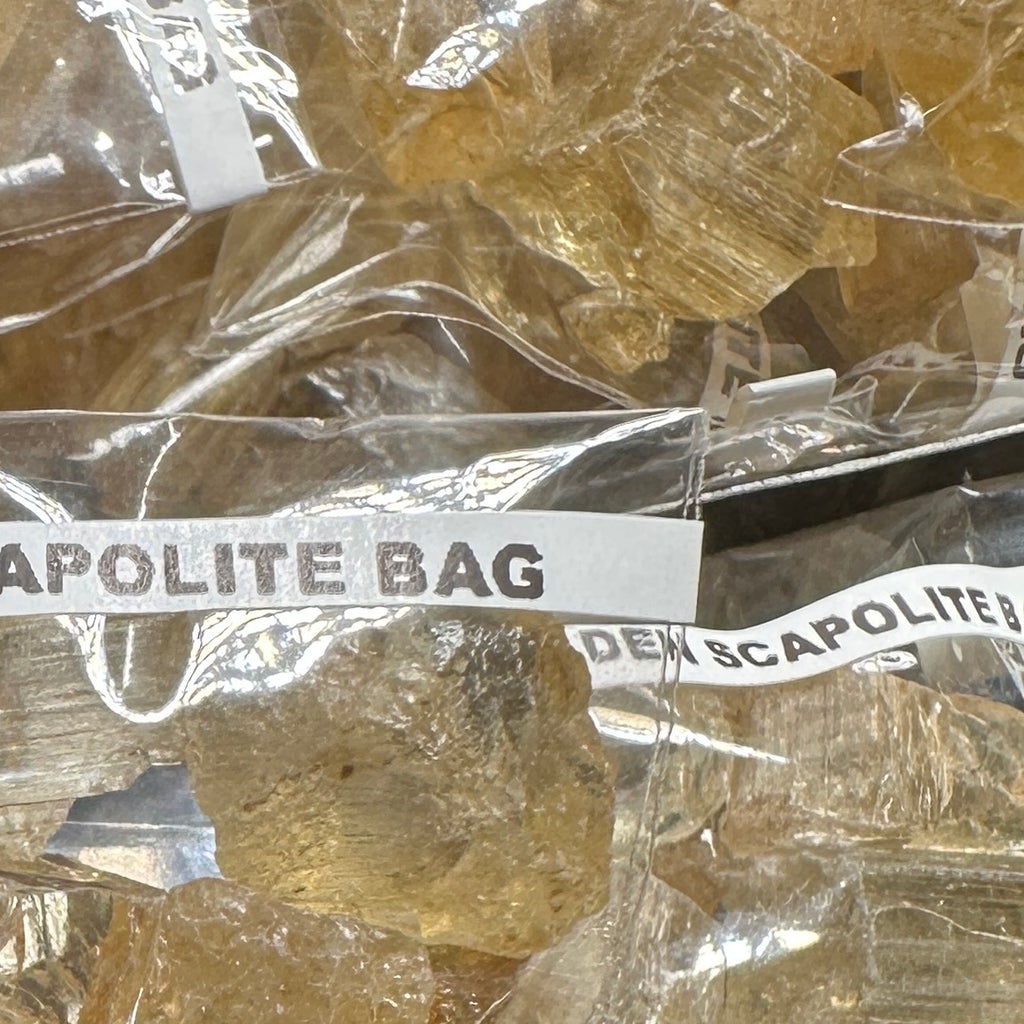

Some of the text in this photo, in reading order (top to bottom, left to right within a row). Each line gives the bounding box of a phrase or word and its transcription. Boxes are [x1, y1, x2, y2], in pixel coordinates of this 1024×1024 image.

[377, 541, 545, 600] BAG
[578, 586, 1024, 669] DEN SCAPOLITE B
